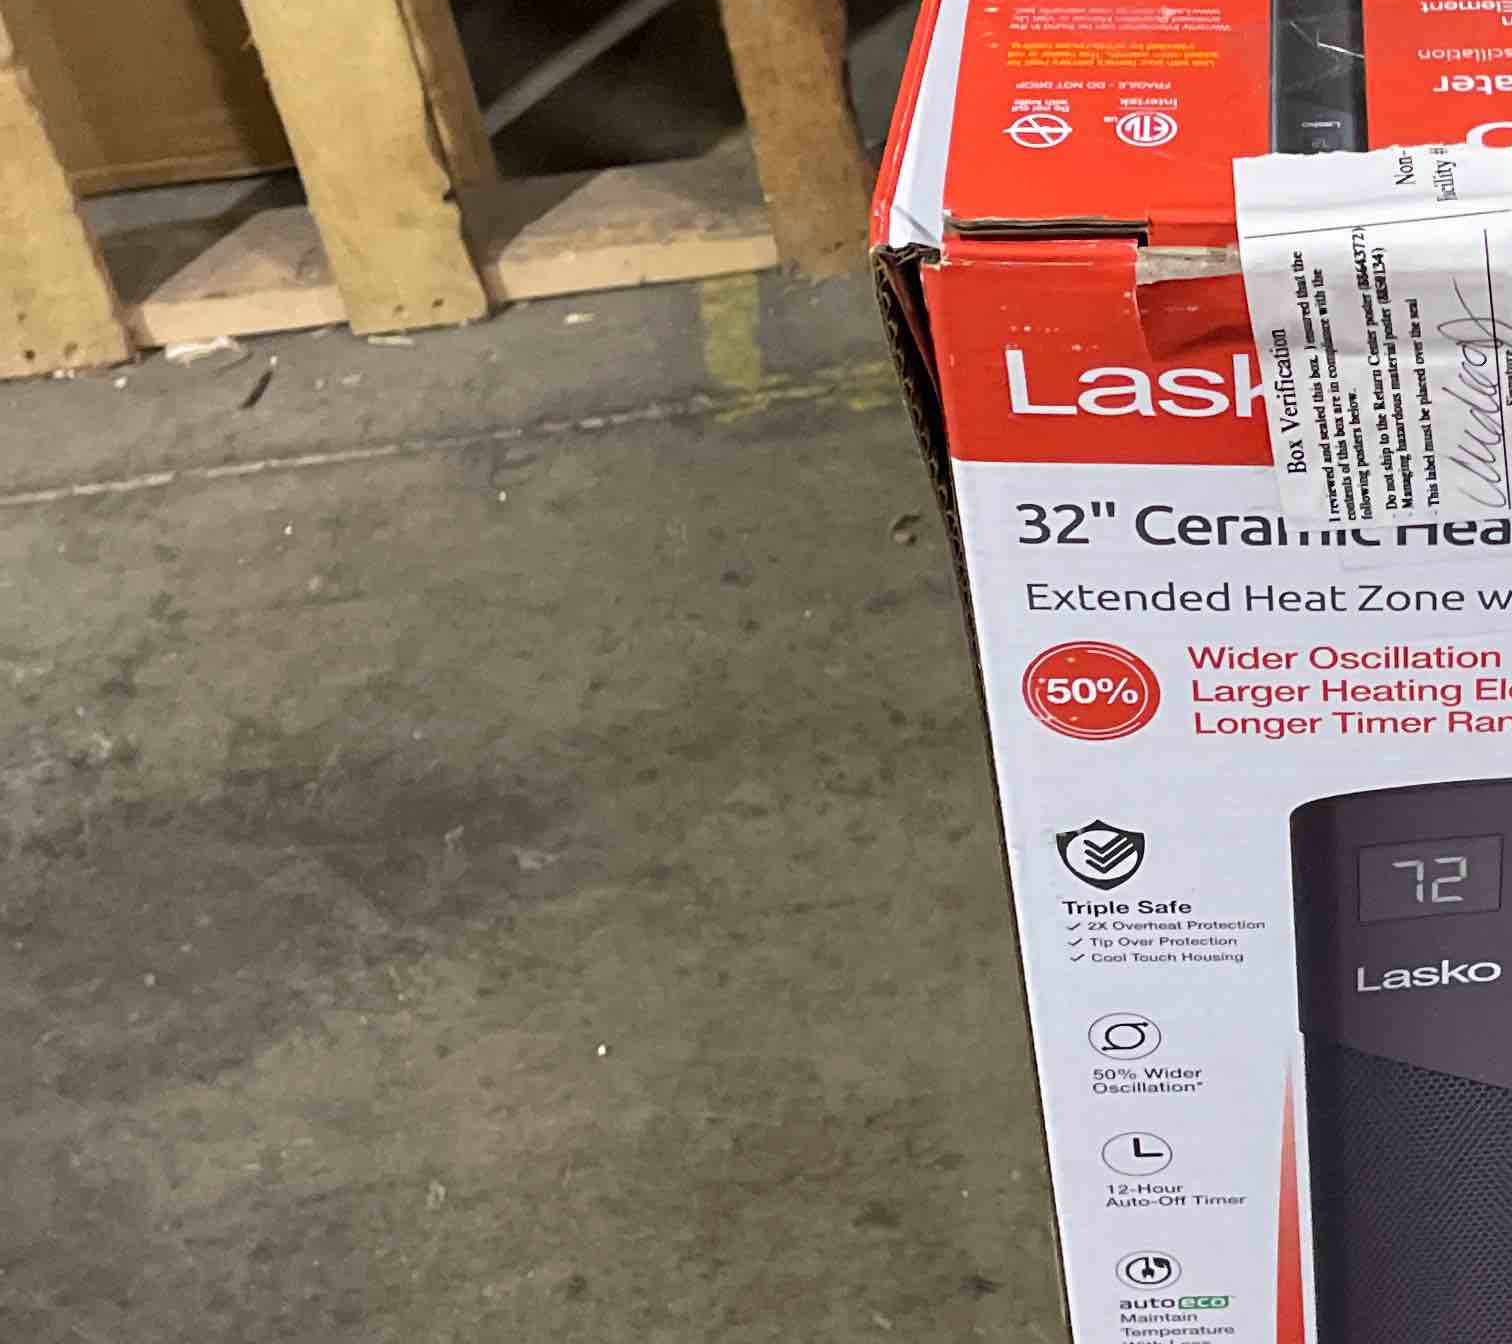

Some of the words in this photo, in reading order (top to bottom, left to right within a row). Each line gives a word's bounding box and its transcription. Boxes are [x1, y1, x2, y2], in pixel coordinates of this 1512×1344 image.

[1120, 97, 1177, 106] Intertek
[1291, 251, 1305, 273] the
[1292, 276, 1309, 298] that
[1311, 269, 1325, 287] the
[1313, 289, 1329, 316] with
[1408, 321, 1422, 338] the
[1009, 349, 1265, 419] Lask
[1269, 328, 1300, 432] Verification
[1369, 369, 1386, 410] Return
[1412, 368, 1432, 405] placed
[1312, 382, 1326, 403] this
[1330, 395, 1342, 414] are
[1416, 408, 1429, 421] be
[1314, 406, 1331, 440] sealed
[1332, 417, 1345, 437] box
[1374, 413, 1388, 431] the
[1390, 393, 1409, 451] hazardous
[1377, 433, 1391, 445] to
[1418, 424, 1434, 451] must
[1286, 440, 1307, 474] Box
[1318, 443, 1333, 463] and
[1335, 440, 1349, 460] this
[1379, 447, 1396, 471] ship
[1337, 462, 1350, 474] of
[1421, 455, 1436, 481] label
[1321, 466, 1340, 514] reviewed
[1383, 474, 1395, 492] not
[1396, 455, 1414, 508] Managing
[1340, 476, 1356, 521] contents
[1353, 469, 1373, 520] following
[1385, 495, 1398, 510] Do
[1426, 484, 1440, 506] This
[1016, 501, 1116, 548] 32"
[1027, 581, 1231, 614] Extended
[1245, 581, 1347, 613] Heat
[1359, 582, 1464, 613] Zone
[1189, 645, 1297, 671] Wider
[1309, 644, 1502, 669] Oscillation
[1045, 676, 1139, 705] 50%
[1191, 677, 1310, 705] Larger
[1321, 676, 1462, 705] Heating
[1195, 710, 1322, 739] Longer
[1333, 710, 1438, 735] Timer
[1393, 855, 1468, 904] 72
[1063, 901, 1129, 916] Triple
[1138, 901, 1192, 914] Safe
[1088, 921, 1108, 930] 2X
[1113, 921, 1182, 930] Overheat
[1187, 920, 1266, 930] Protection
[1159, 935, 1238, 946] Protection
[1357, 959, 1502, 992] Lasko
[1093, 1069, 1137, 1080] 50%
[1144, 1067, 1202, 1079] Wider
[1108, 1183, 1183, 1194] 12-Hour
[1193, 1194, 1246, 1206] Timer
[1121, 1312, 1198, 1323] Maintain
[1123, 1325, 1235, 1338] Temperature
